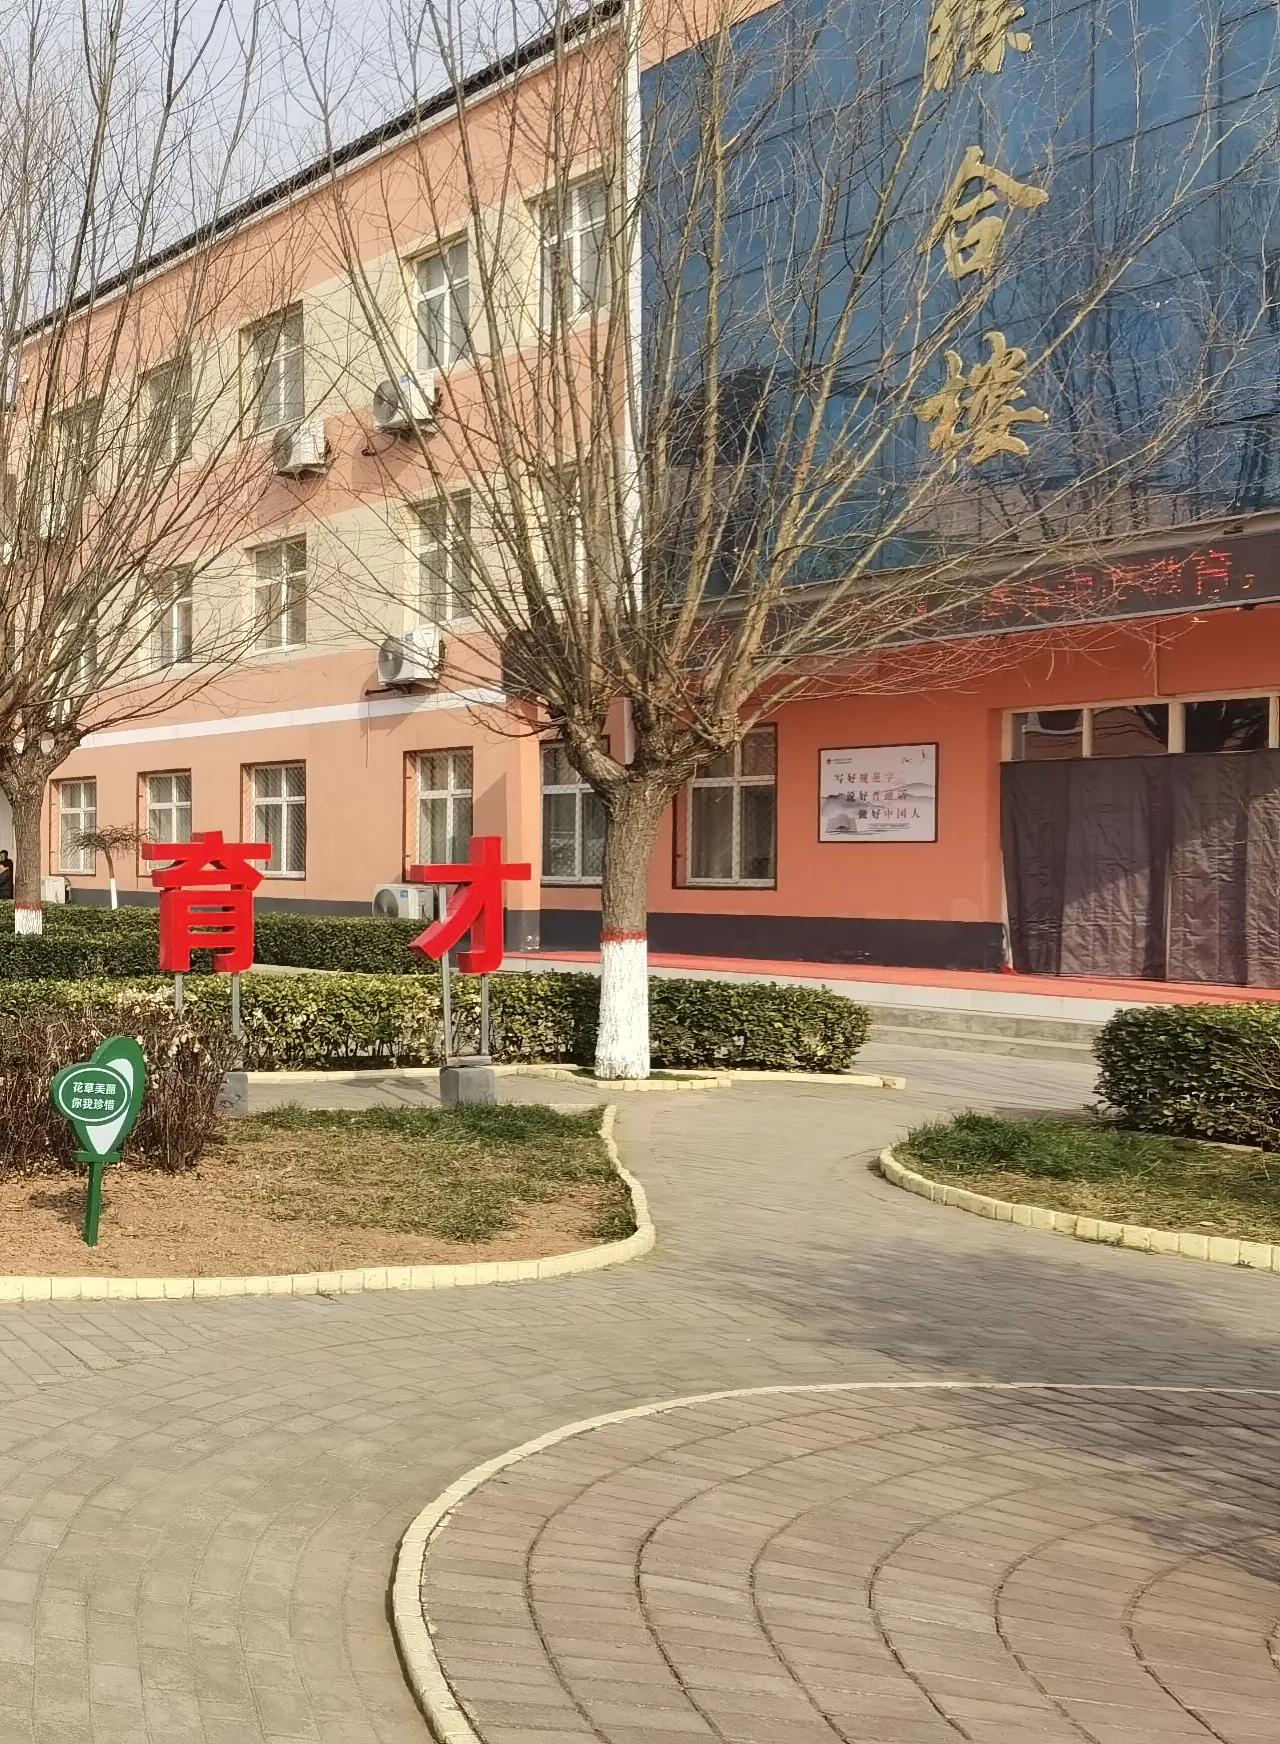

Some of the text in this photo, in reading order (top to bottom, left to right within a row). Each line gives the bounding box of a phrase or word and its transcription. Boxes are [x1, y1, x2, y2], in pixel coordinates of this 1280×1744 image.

[73, 1082, 117, 1095] 花草美丽
[71, 1097, 115, 1111] 你我珍惜
